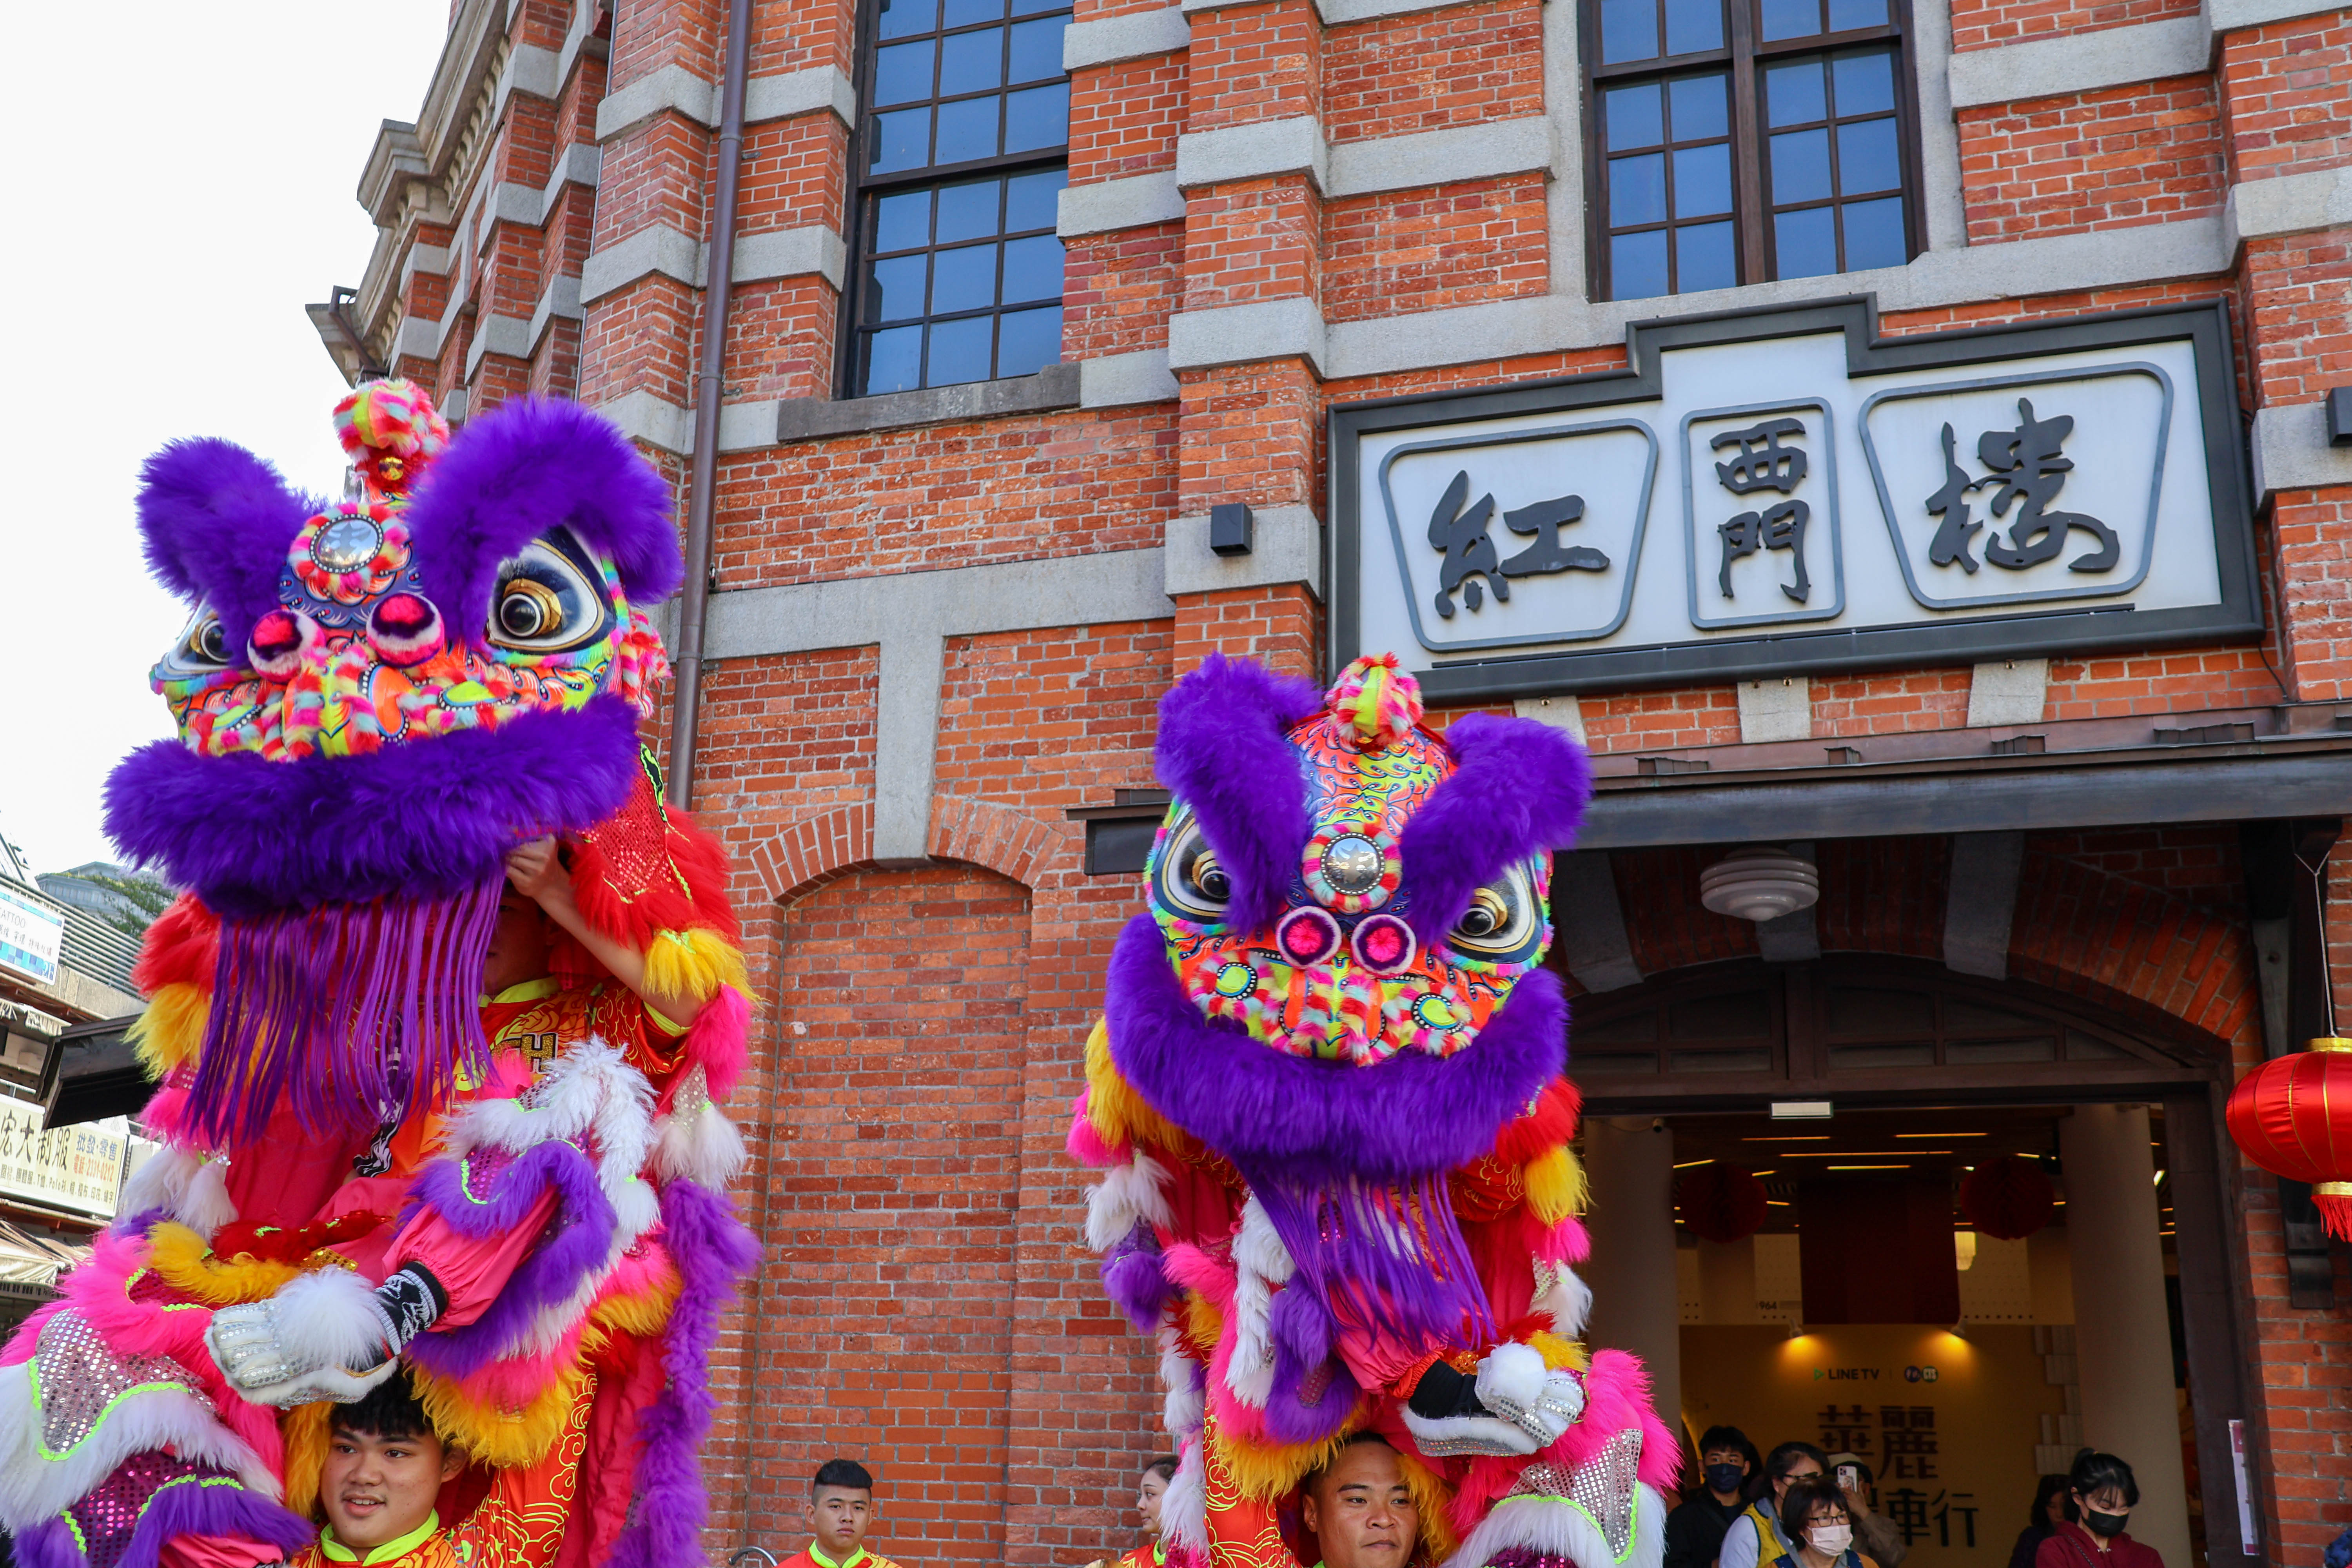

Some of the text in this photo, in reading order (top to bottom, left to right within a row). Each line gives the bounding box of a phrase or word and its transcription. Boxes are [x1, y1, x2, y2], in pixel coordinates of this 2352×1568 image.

[0, 907, 25, 928] ATTOO
[1828, 1368, 1880, 1380] LINE TV
